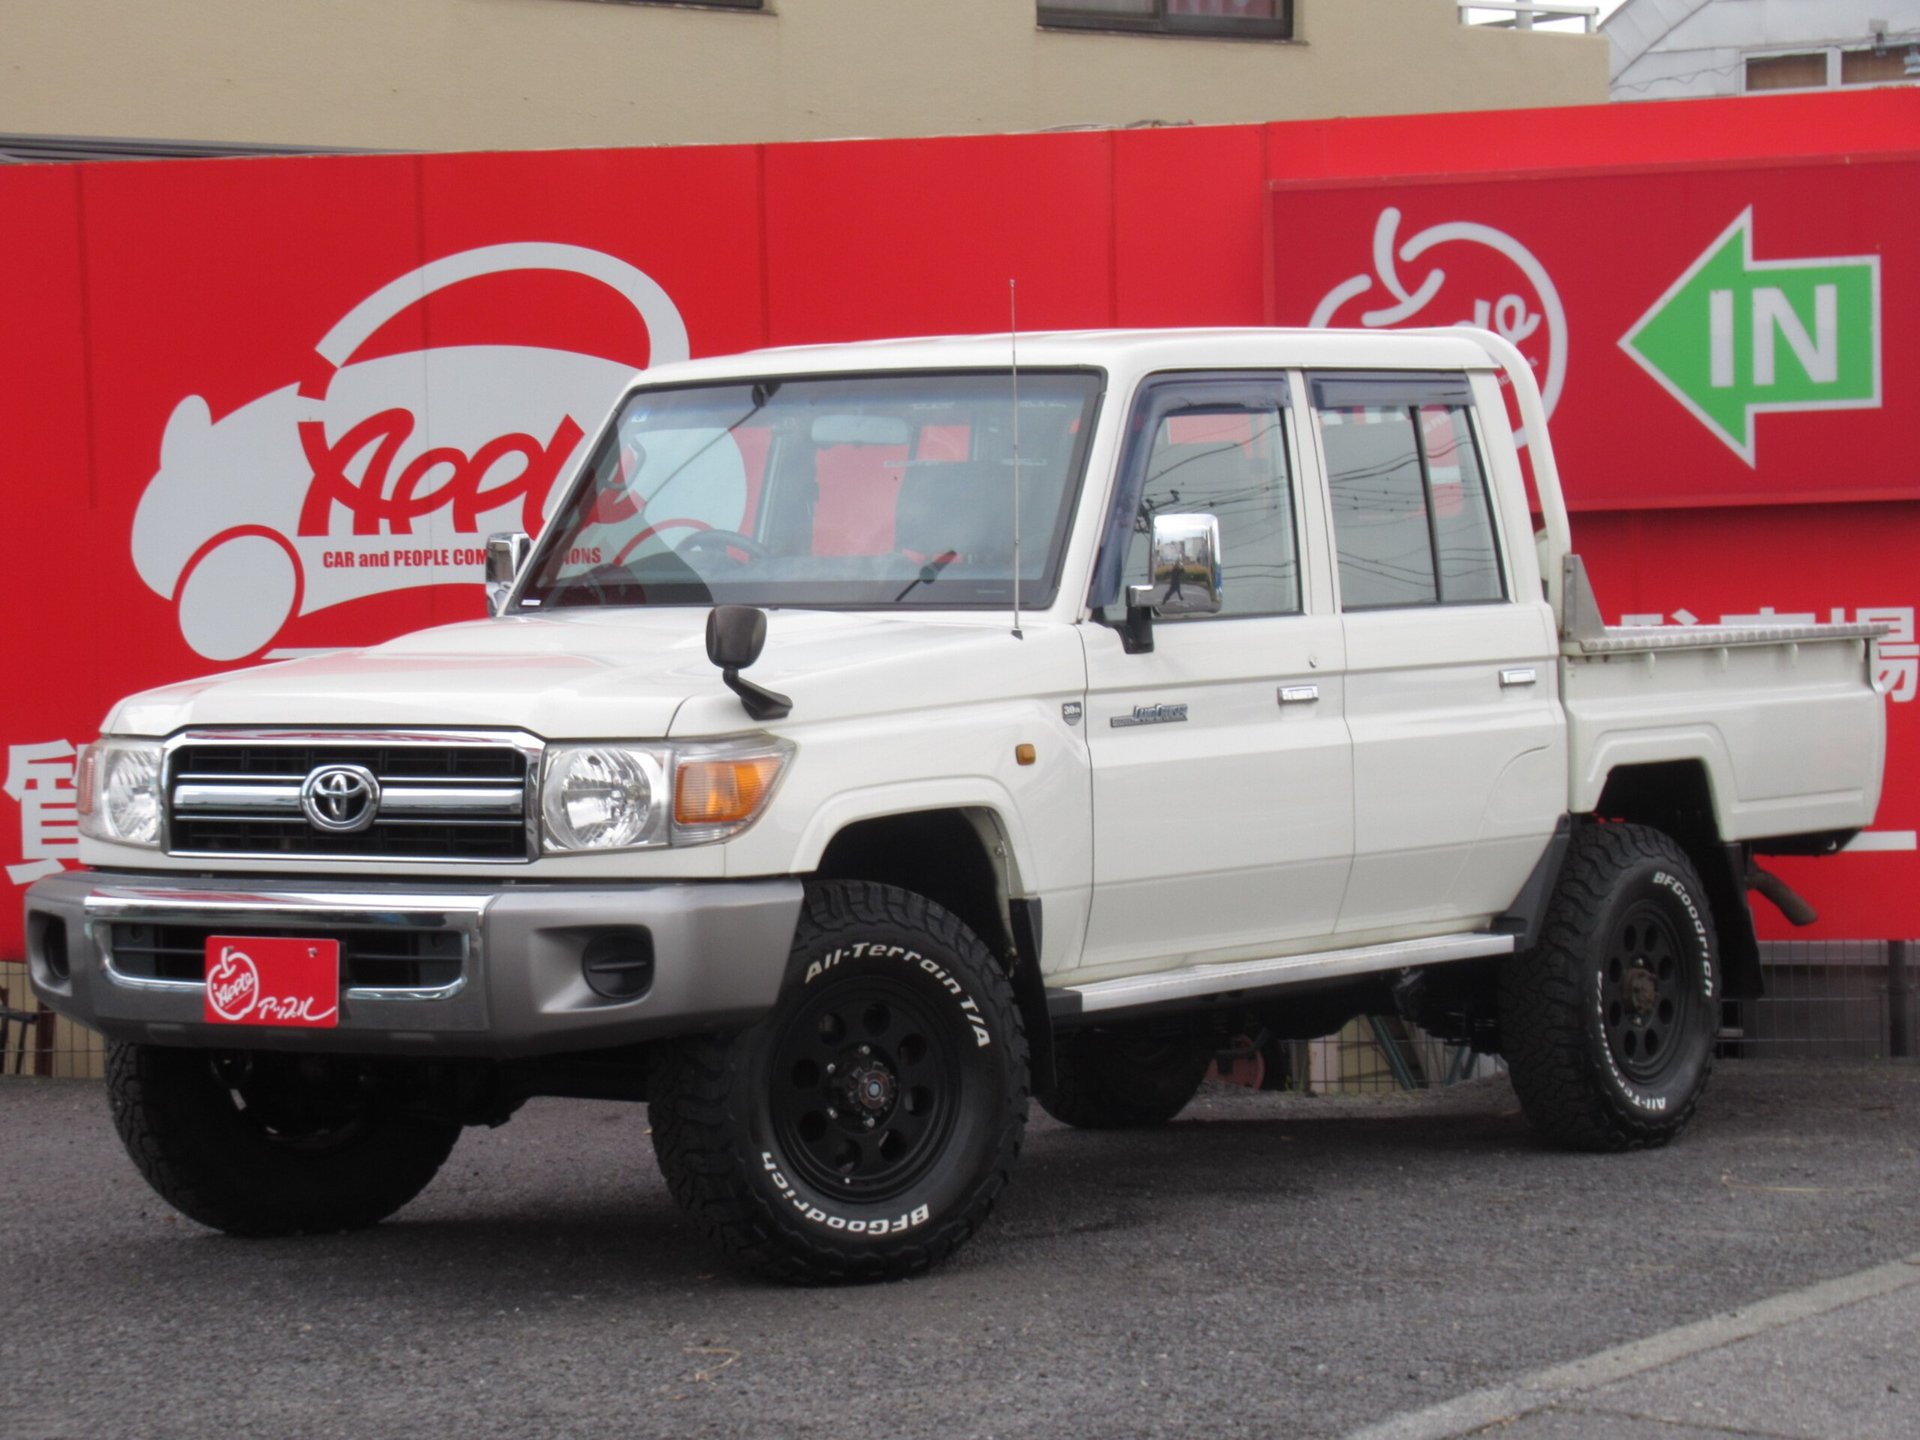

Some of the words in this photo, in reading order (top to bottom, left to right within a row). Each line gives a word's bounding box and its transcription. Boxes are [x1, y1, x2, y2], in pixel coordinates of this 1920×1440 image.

[1709, 284, 1838, 387] IN
[322, 551, 355, 568] CAR
[359, 551, 389, 567] and
[394, 549, 449, 566] PEOPLE
[1653, 870, 1714, 998] BFGoodrich
[804, 942, 963, 995] All-Terrain
[959, 994, 991, 1048] T/A
[762, 1151, 931, 1236] BFGoodrich
